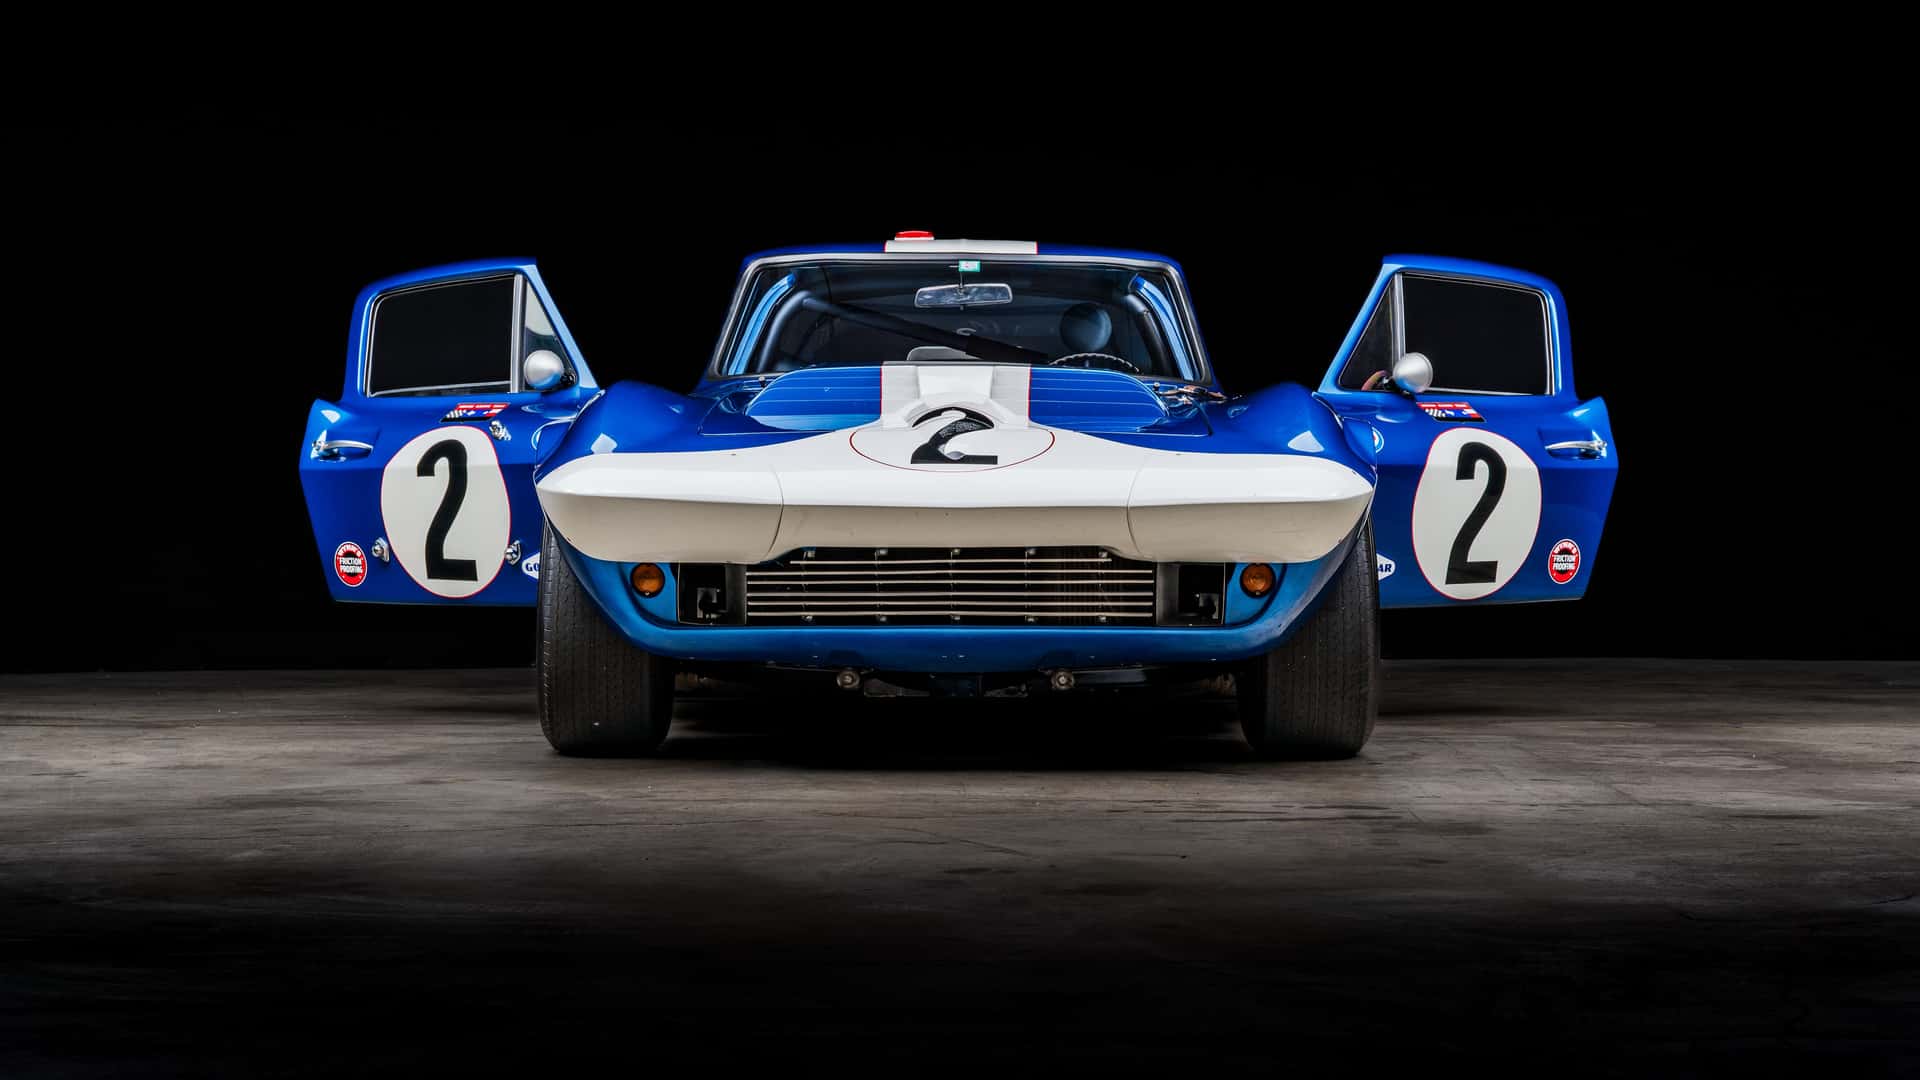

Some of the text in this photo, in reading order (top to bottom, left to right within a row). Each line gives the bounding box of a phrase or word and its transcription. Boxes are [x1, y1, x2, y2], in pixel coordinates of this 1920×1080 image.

[911, 406, 998, 464] 2
[416, 439, 478, 581] 2
[1445, 441, 1508, 585] 2
